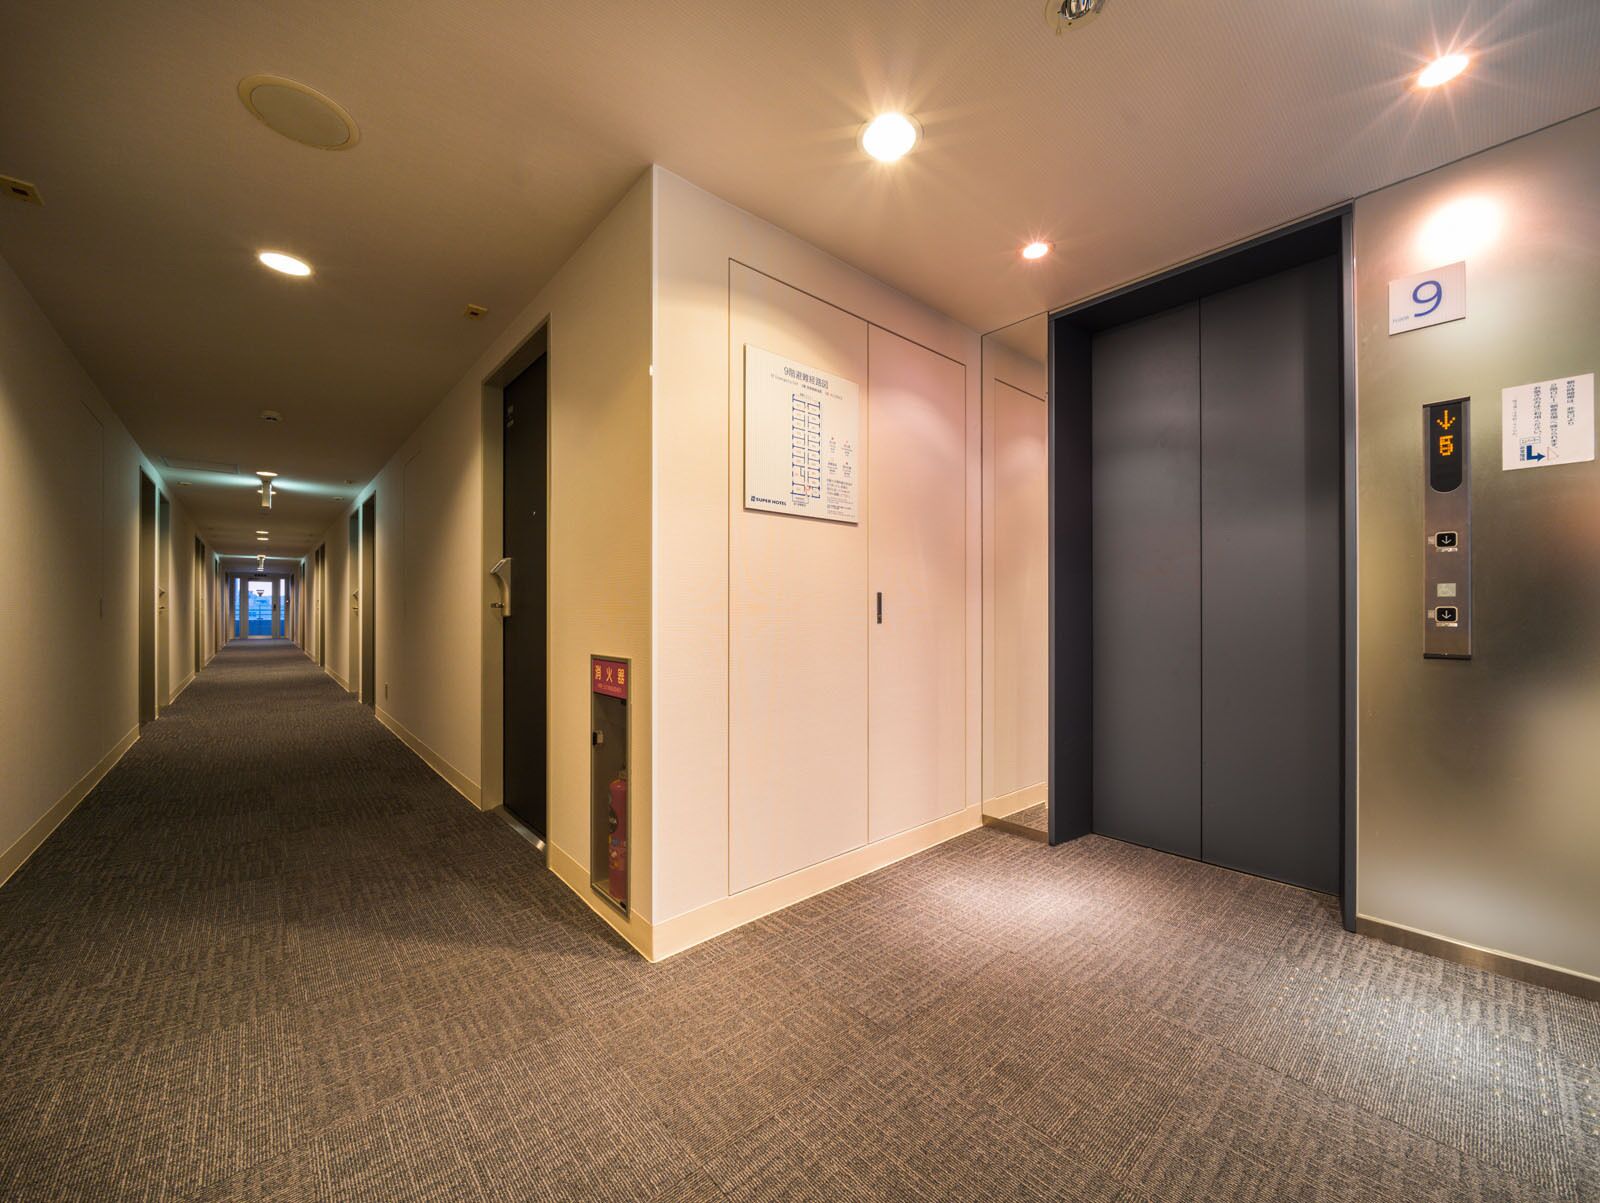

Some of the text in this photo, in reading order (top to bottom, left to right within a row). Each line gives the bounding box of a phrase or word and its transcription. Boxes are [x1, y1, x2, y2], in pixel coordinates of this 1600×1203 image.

[1412, 280, 1443, 318] 9
[755, 496, 771, 504] SUPER
[595, 664, 625, 685] 消火器
